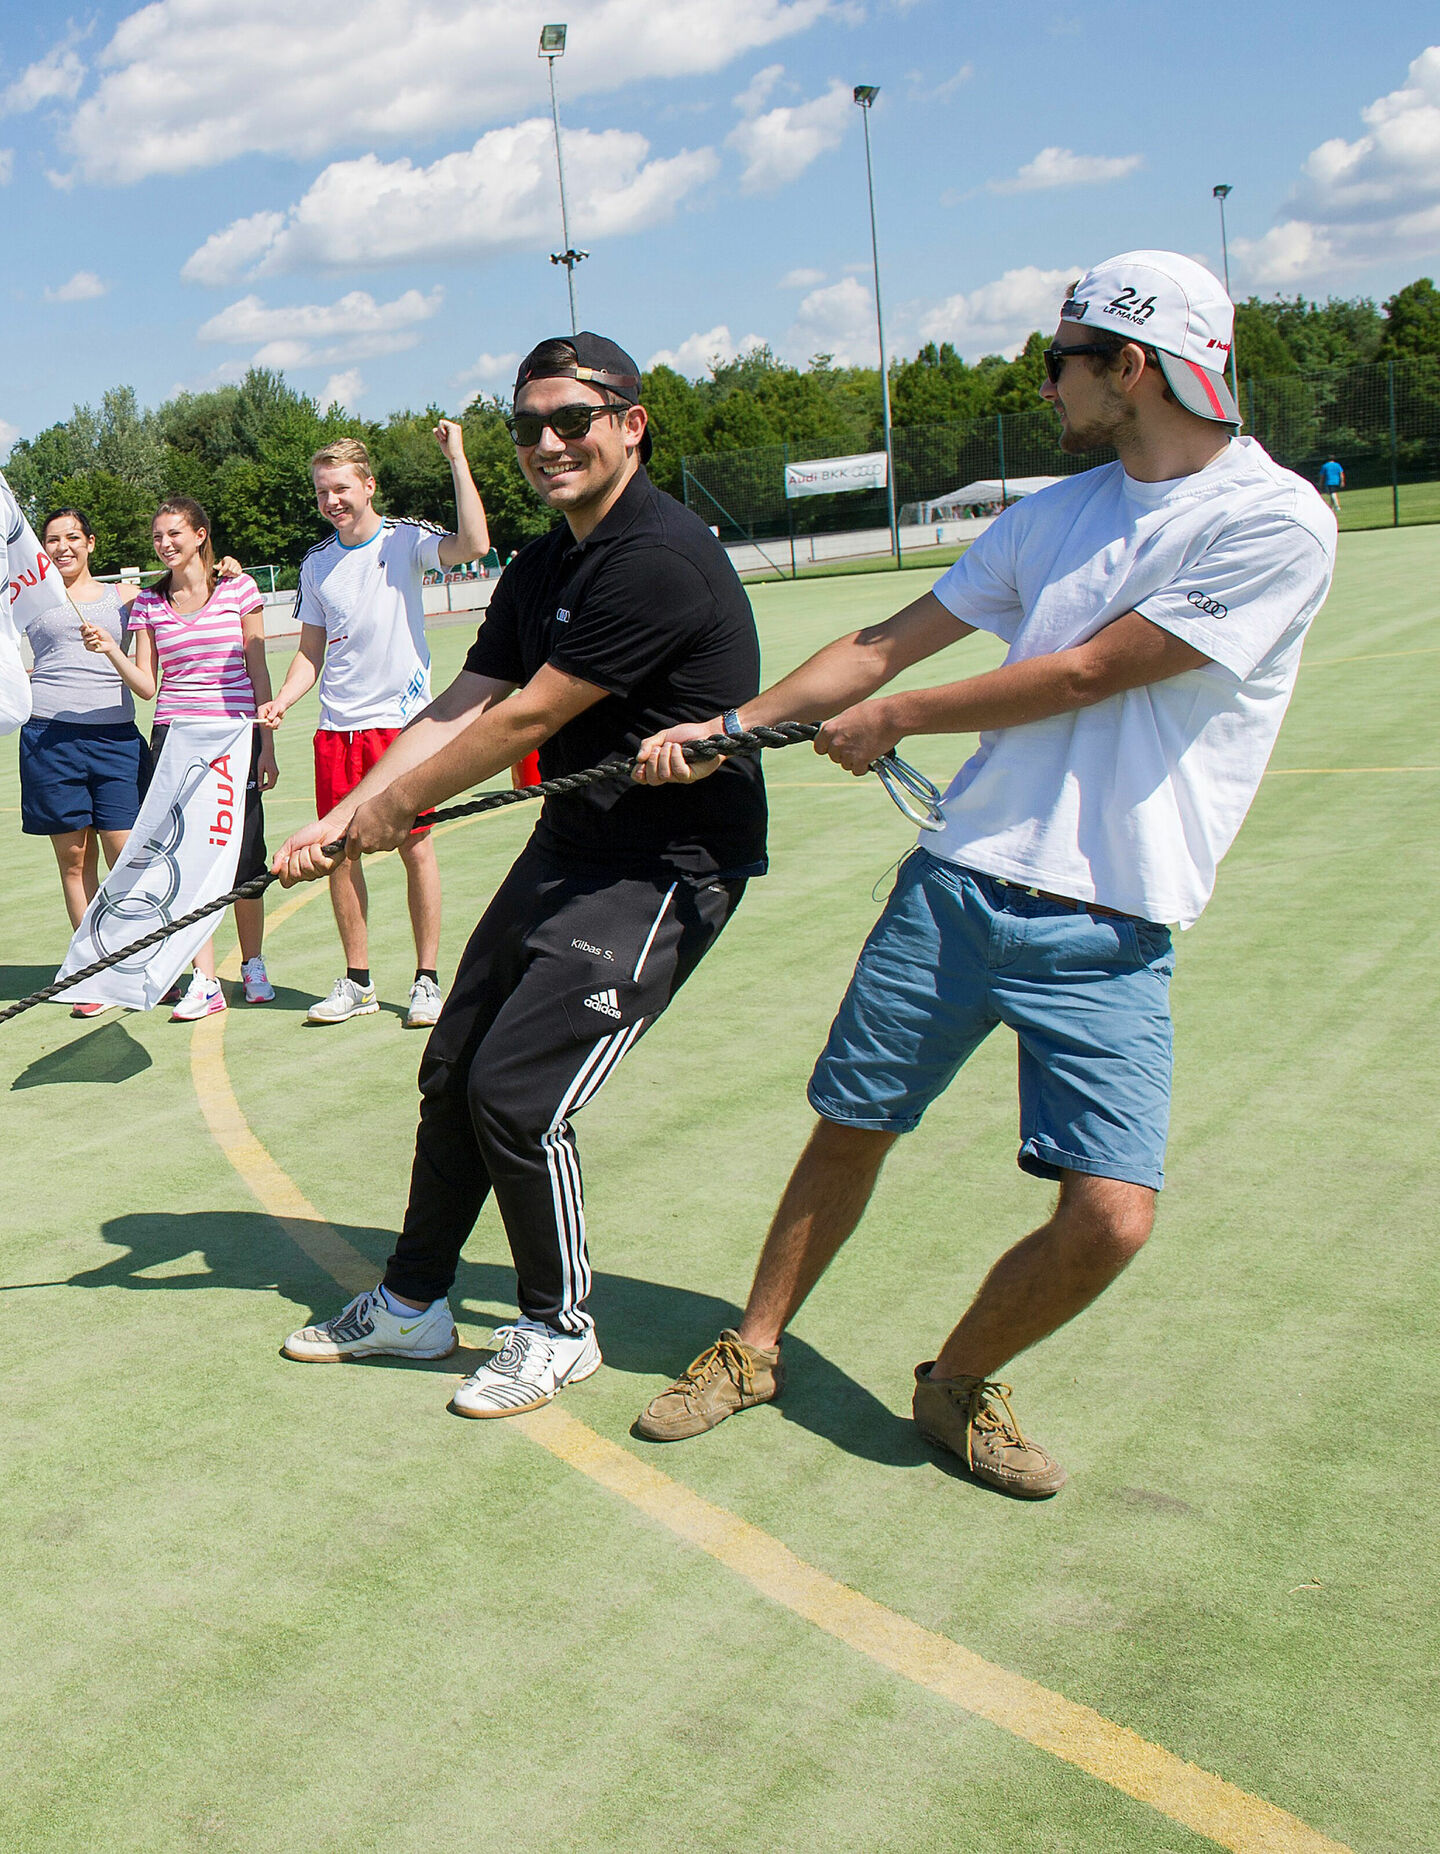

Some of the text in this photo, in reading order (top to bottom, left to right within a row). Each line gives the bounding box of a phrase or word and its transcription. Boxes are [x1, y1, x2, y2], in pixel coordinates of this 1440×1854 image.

[1103, 305, 1146, 326] LE MANS
[788, 470, 848, 485] Audi BKK
[570, 938, 615, 962] Kilbas S.
[583, 998, 622, 1020] adidas
